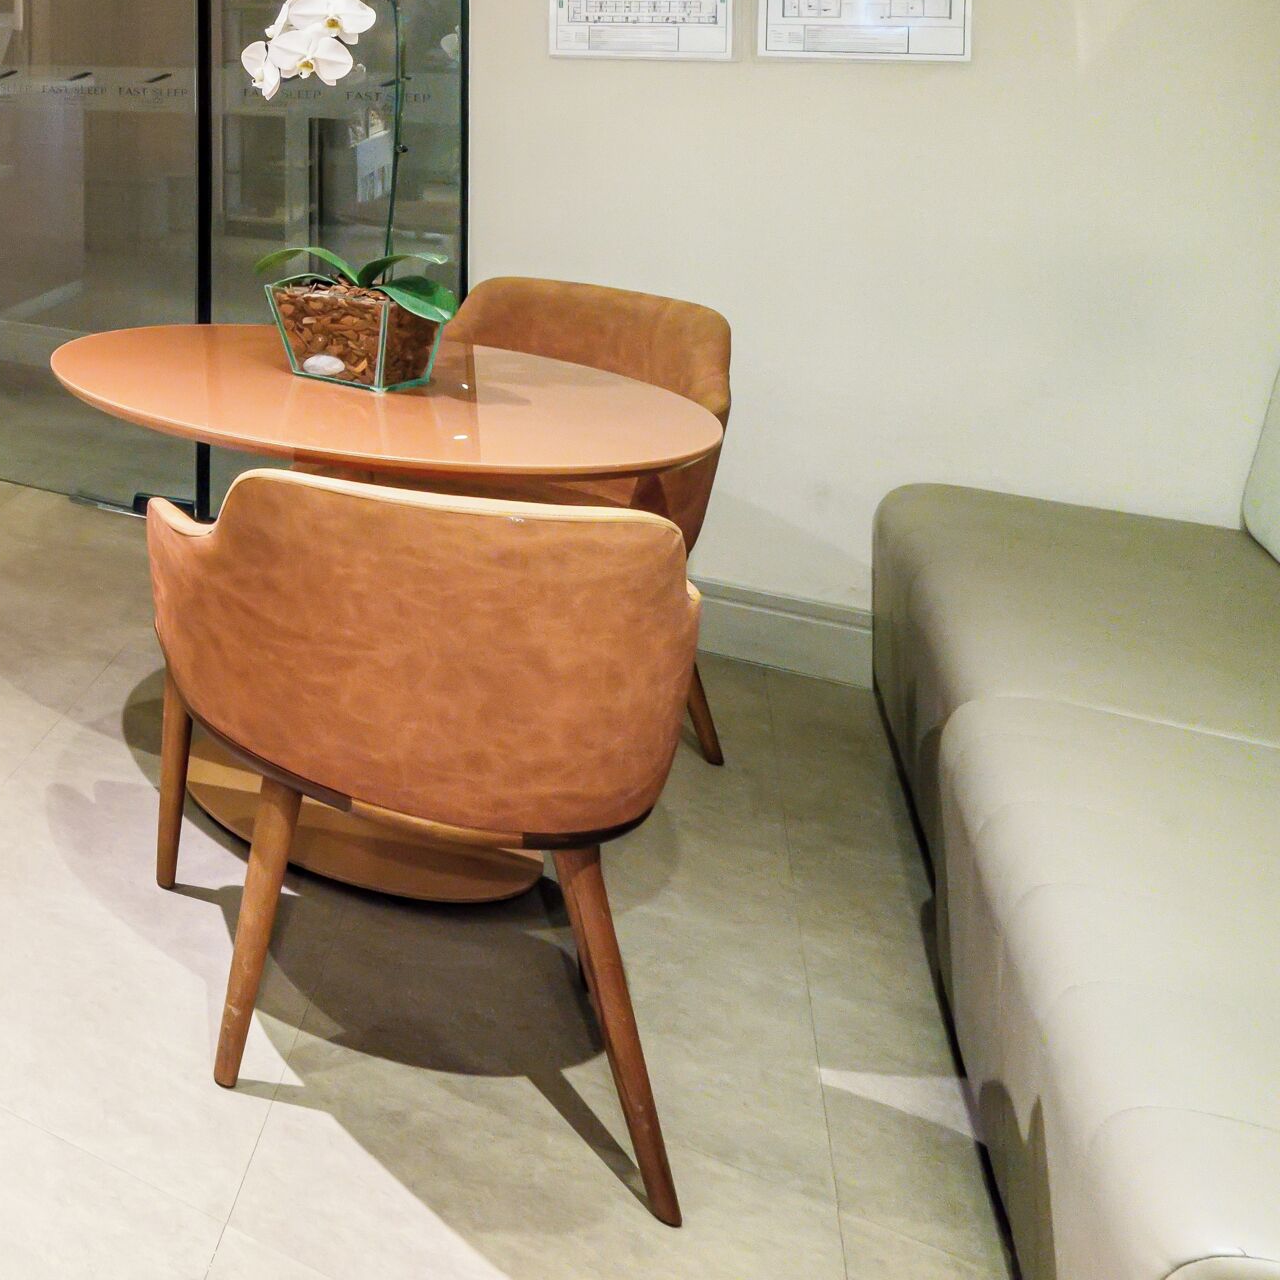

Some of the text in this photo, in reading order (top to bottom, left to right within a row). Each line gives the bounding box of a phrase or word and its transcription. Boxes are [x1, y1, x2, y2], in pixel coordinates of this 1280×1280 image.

[42, 84, 108, 95] FAST SLEEP
[119, 87, 188, 97] FAST SLEEP
[284, 89, 321, 99] SLEEP
[345, 91, 380, 101] FAST
